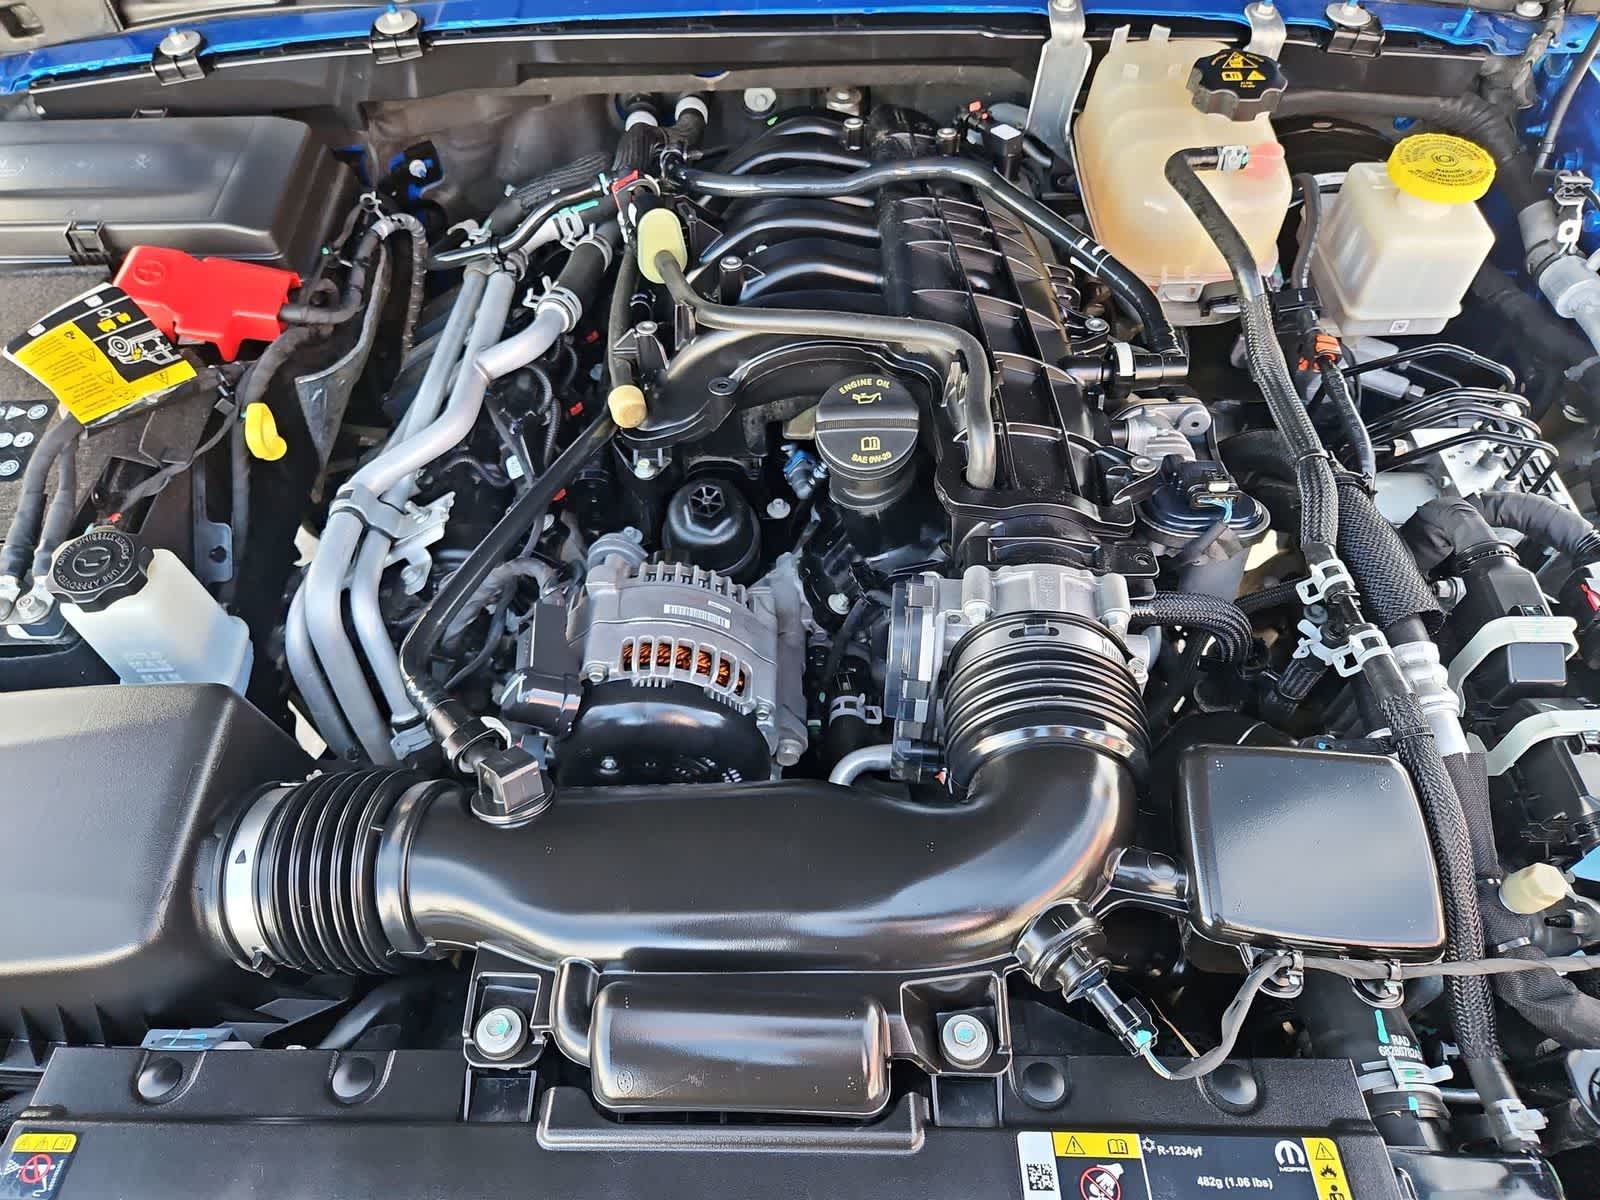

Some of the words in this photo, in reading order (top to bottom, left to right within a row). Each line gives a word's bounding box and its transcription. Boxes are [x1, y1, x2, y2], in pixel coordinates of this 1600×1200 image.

[839, 378, 873, 394] ENGINE
[876, 379, 891, 389] OIL
[851, 453, 868, 464] SAE
[1391, 1034, 1410, 1047] RAD
[1157, 1145, 1202, 1158] R-1234yf
[1197, 1176, 1223, 1189] 482g
[1225, 1177, 1250, 1189] (1.06
[1252, 1177, 1273, 1190] lbs)
